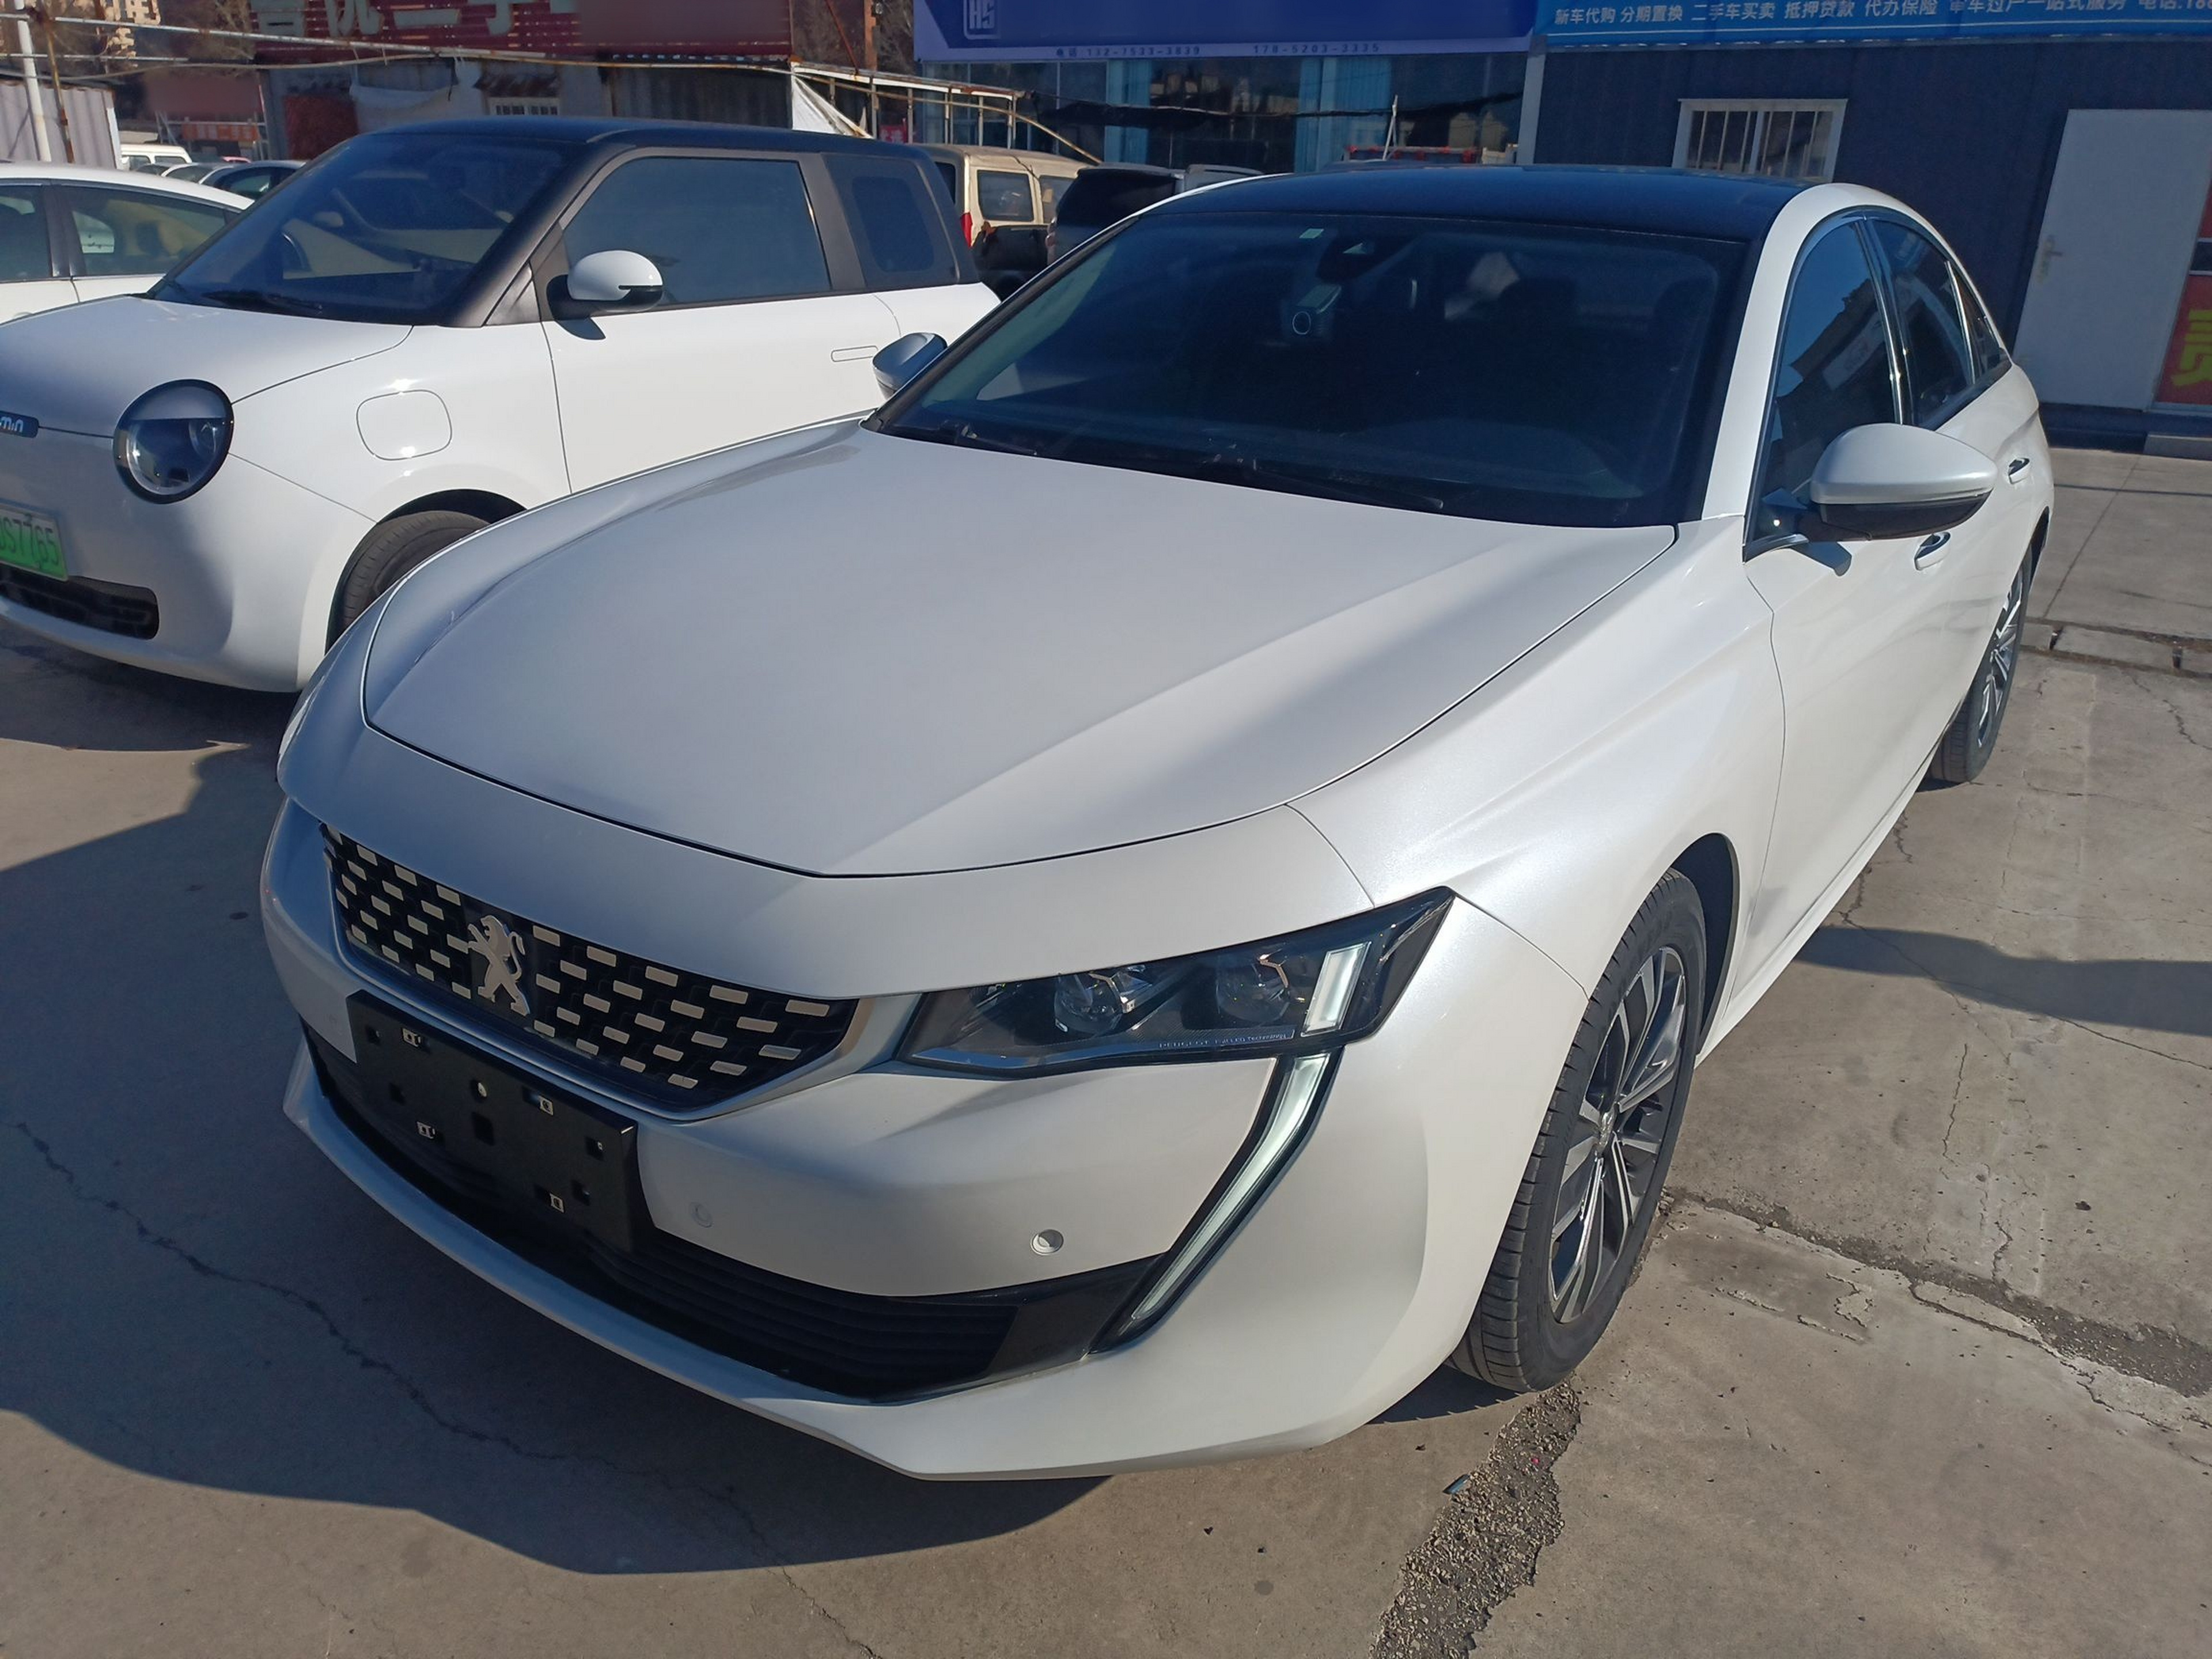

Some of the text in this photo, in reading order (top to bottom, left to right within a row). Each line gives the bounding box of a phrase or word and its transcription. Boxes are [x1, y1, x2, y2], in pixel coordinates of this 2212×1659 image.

[1554, 7, 1615, 25] 新车代购
[1620, 5, 1683, 23] 分期置换
[1691, 2, 1775, 21] 二手车买卖
[1784, 0, 1855, 19] 抵押贷款
[1865, 0, 1938, 17] 代办保险
